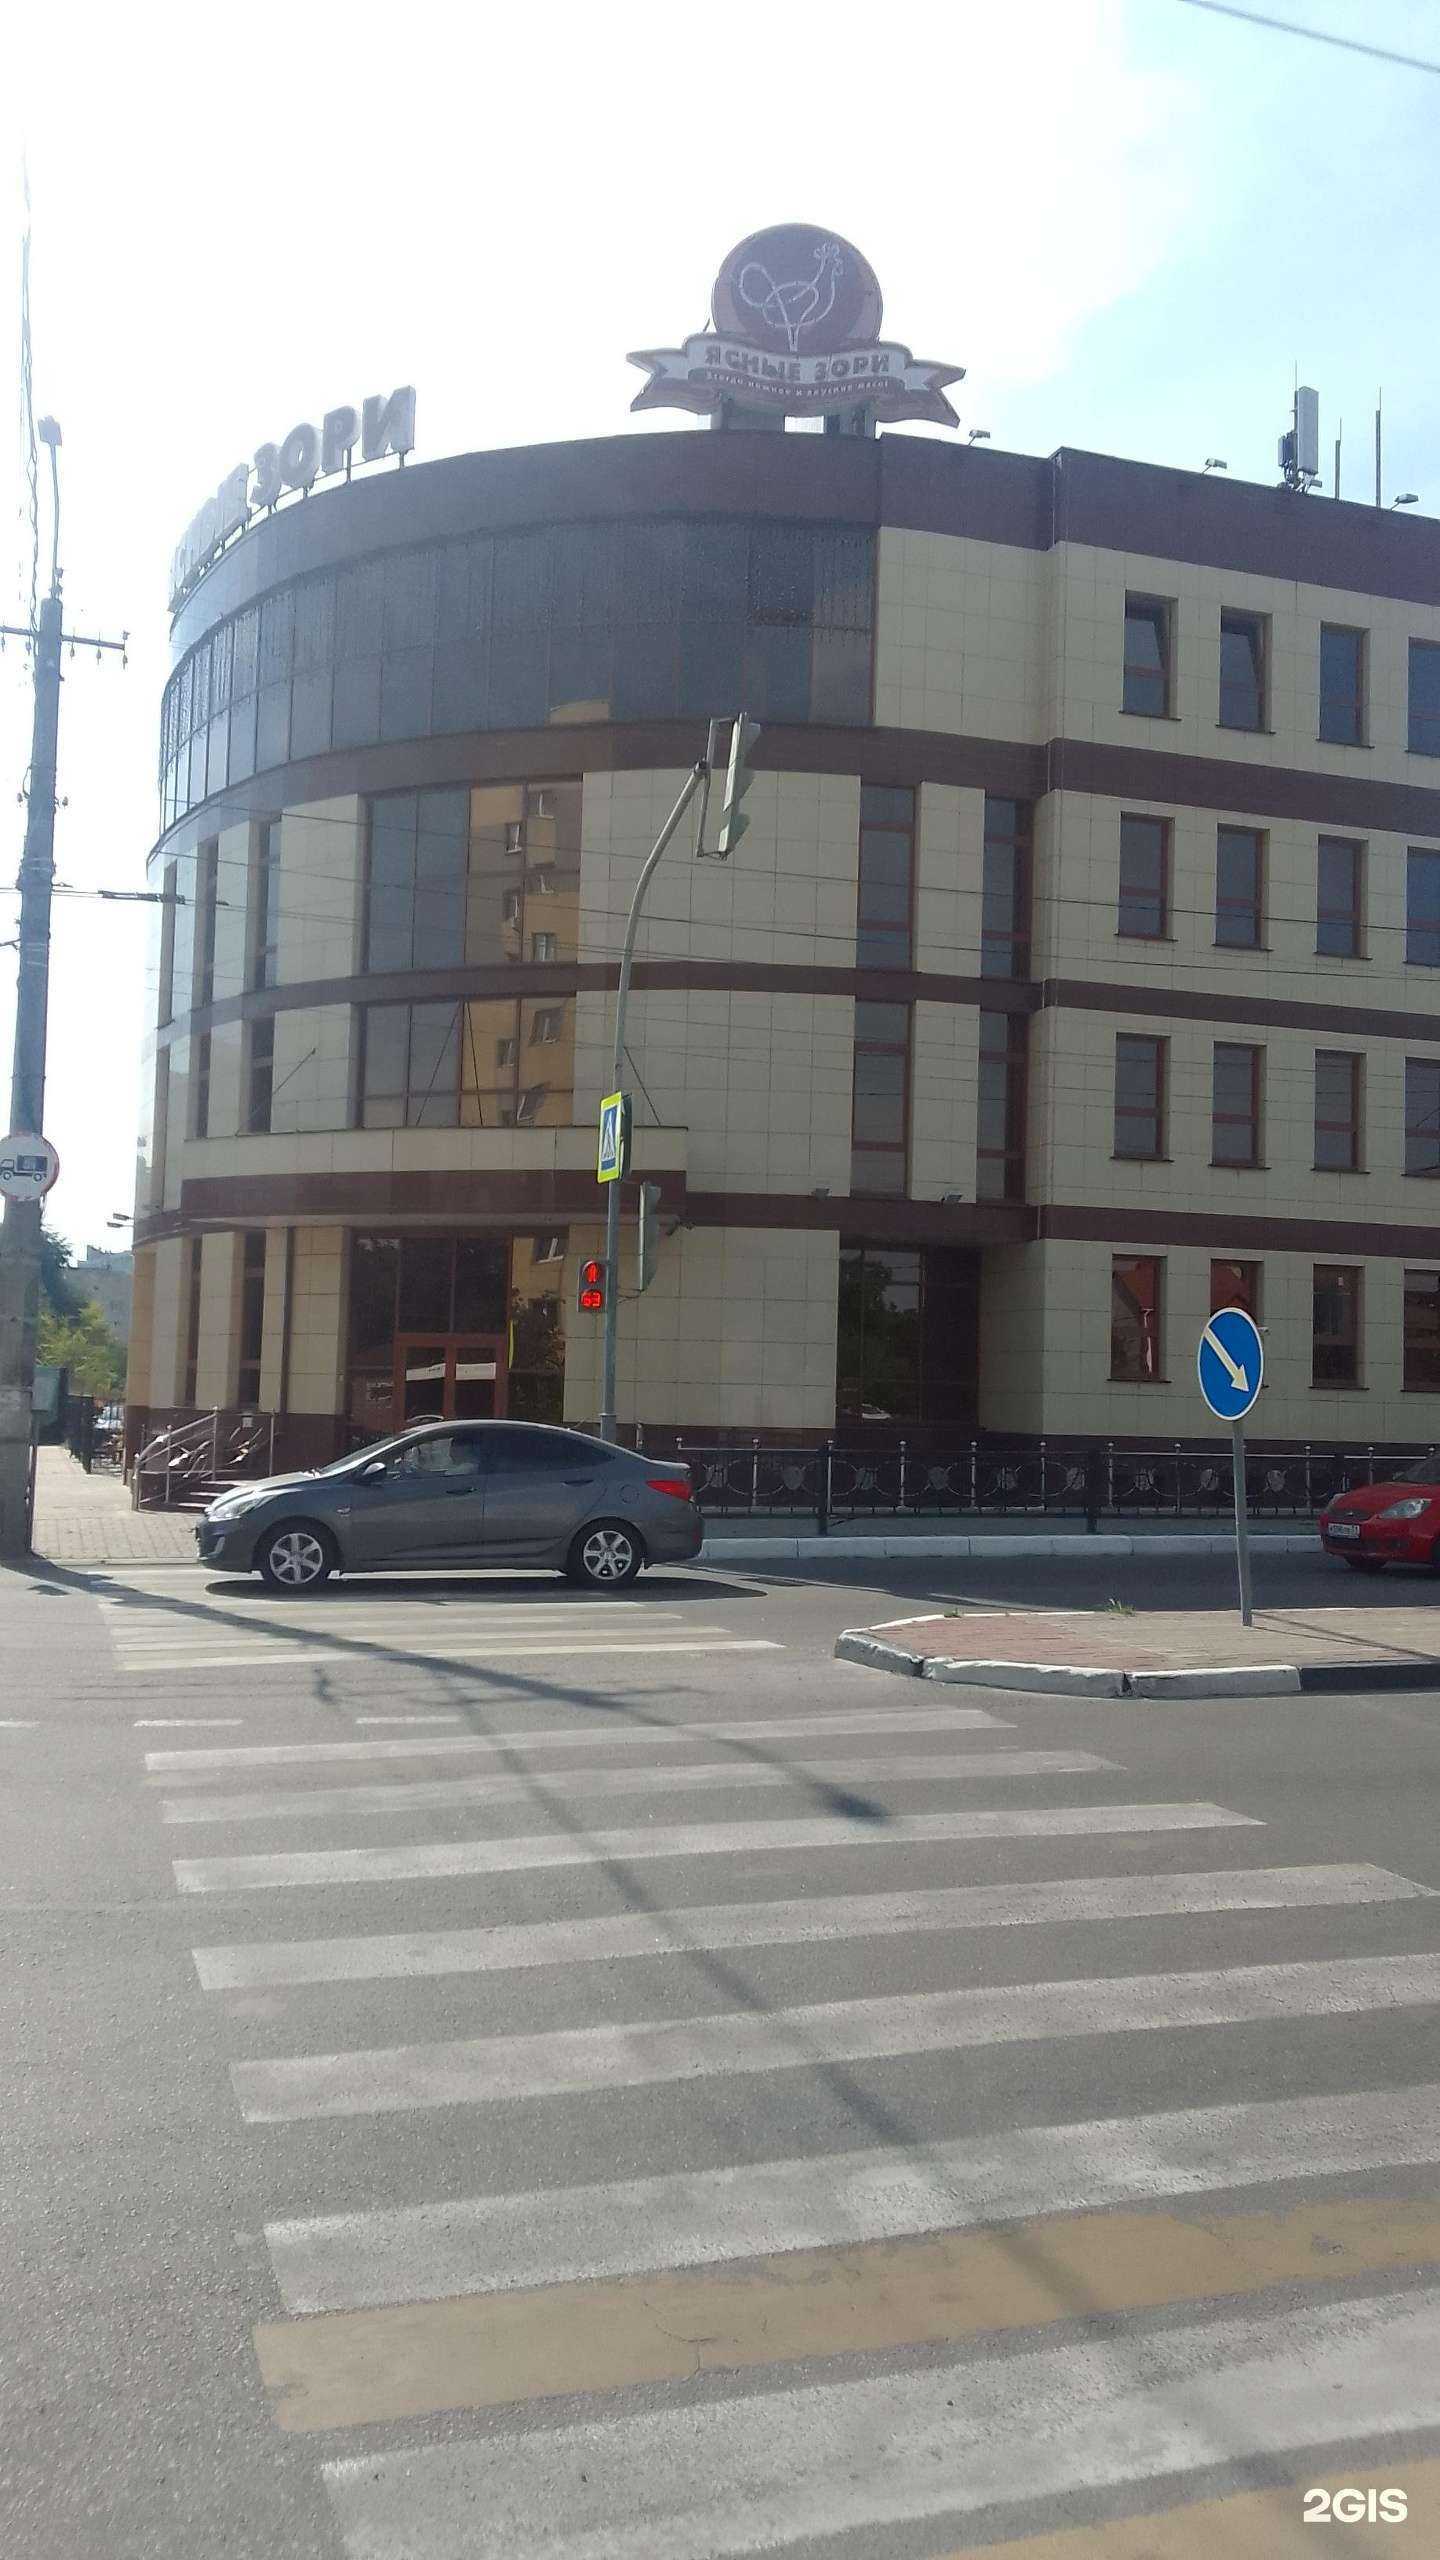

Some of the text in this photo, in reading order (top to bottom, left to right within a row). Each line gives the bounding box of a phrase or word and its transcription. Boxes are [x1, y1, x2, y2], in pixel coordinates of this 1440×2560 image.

[704, 344, 890, 382] ЯСНЫЕ ЗОРИ
[250, 384, 417, 507] ЗОРИ
